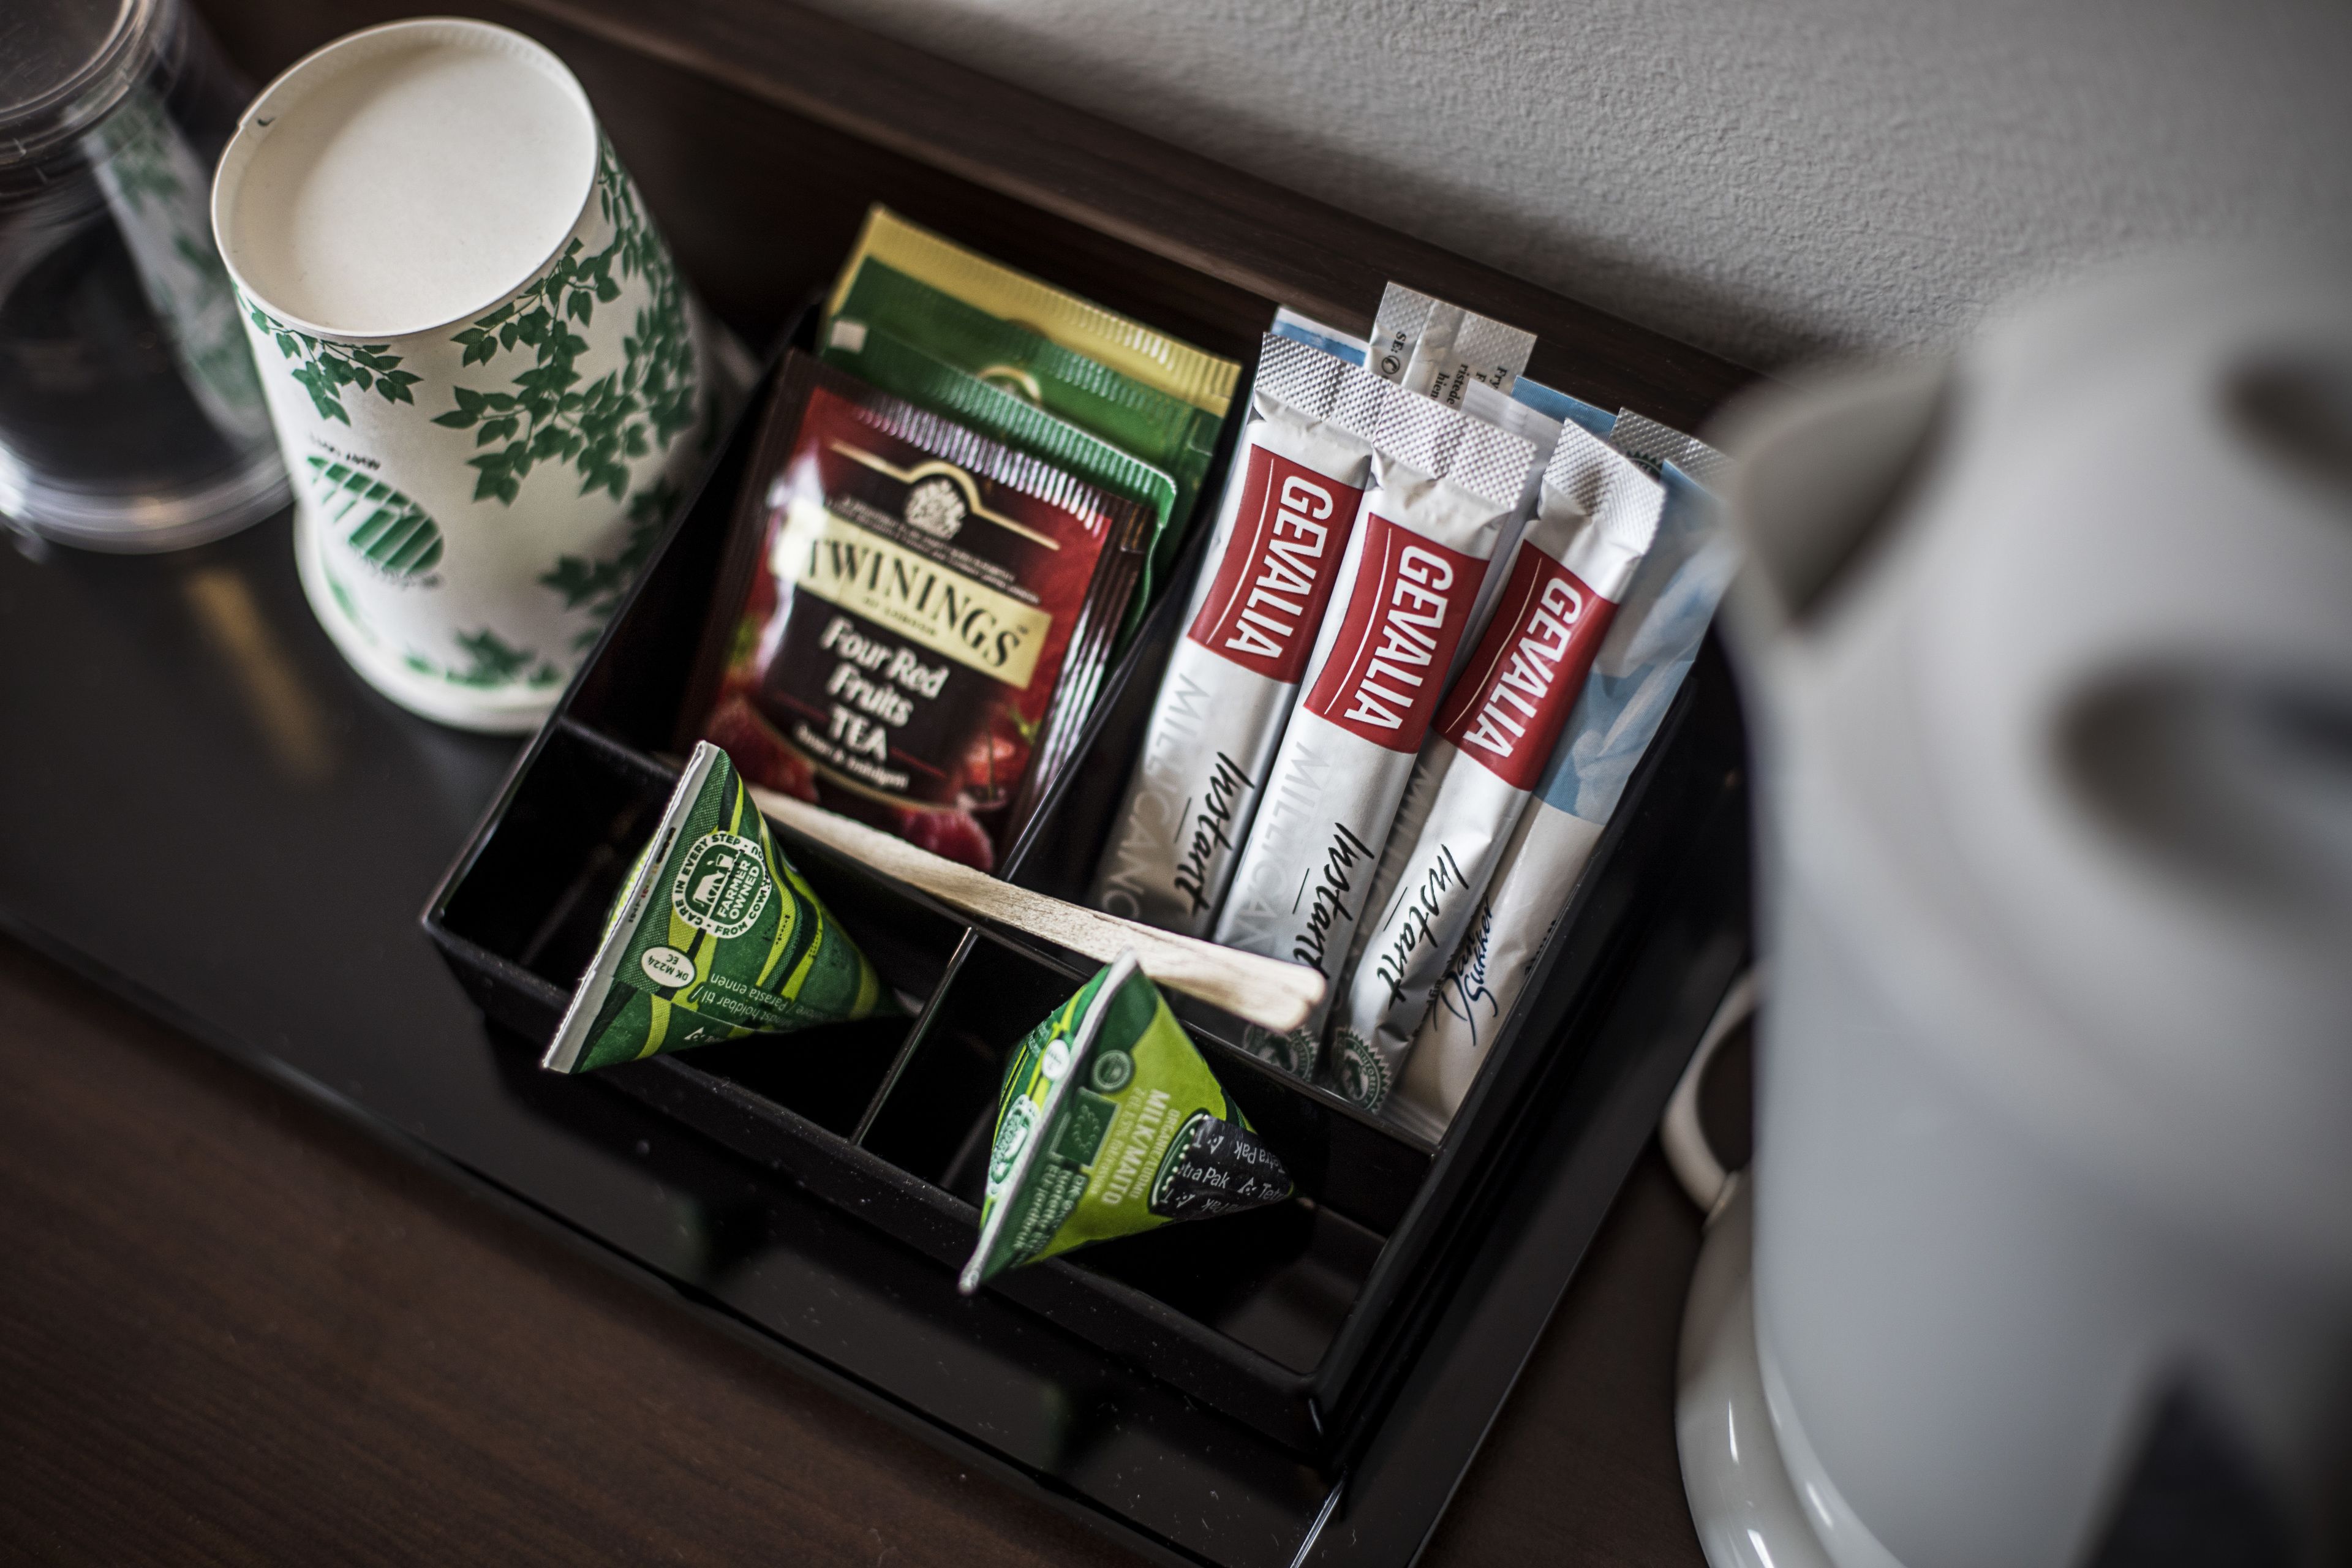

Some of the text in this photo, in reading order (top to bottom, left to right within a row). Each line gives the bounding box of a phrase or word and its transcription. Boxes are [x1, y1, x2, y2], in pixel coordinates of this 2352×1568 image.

[1390, 331, 1407, 353] SE:
[1447, 364, 1469, 405] ristede
[1225, 475, 1334, 659] GEVALIA
[821, 616, 949, 699] Four Red
[1344, 545, 1455, 730] GEVALIA
[827, 662, 914, 728] Fruits
[1462, 577, 1583, 758] GEVALIA
[829, 704, 887, 762] TEA
[1174, 751, 1255, 917] Instant
[1227, 741, 1330, 954] MILLICAN
[675, 833, 742, 925] CARE IN EVERY STEP
[717, 859, 752, 918] FARMER
[729, 865, 760, 919] OWNED
[1292, 822, 1375, 980] Instant
[714, 921, 748, 936] FROM
[1377, 843, 1469, 1011] Instant
[647, 956, 689, 981] DK M224
[666, 954, 679, 965] EC
[709, 973, 748, 996] ennen
[701, 990, 717, 1006] til
[717, 997, 760, 1021] holdbar
[748, 987, 788, 1011] Parasta
[1178, 1162, 1231, 1189] tra Pak
[1234, 1140, 1256, 1164] Pak
